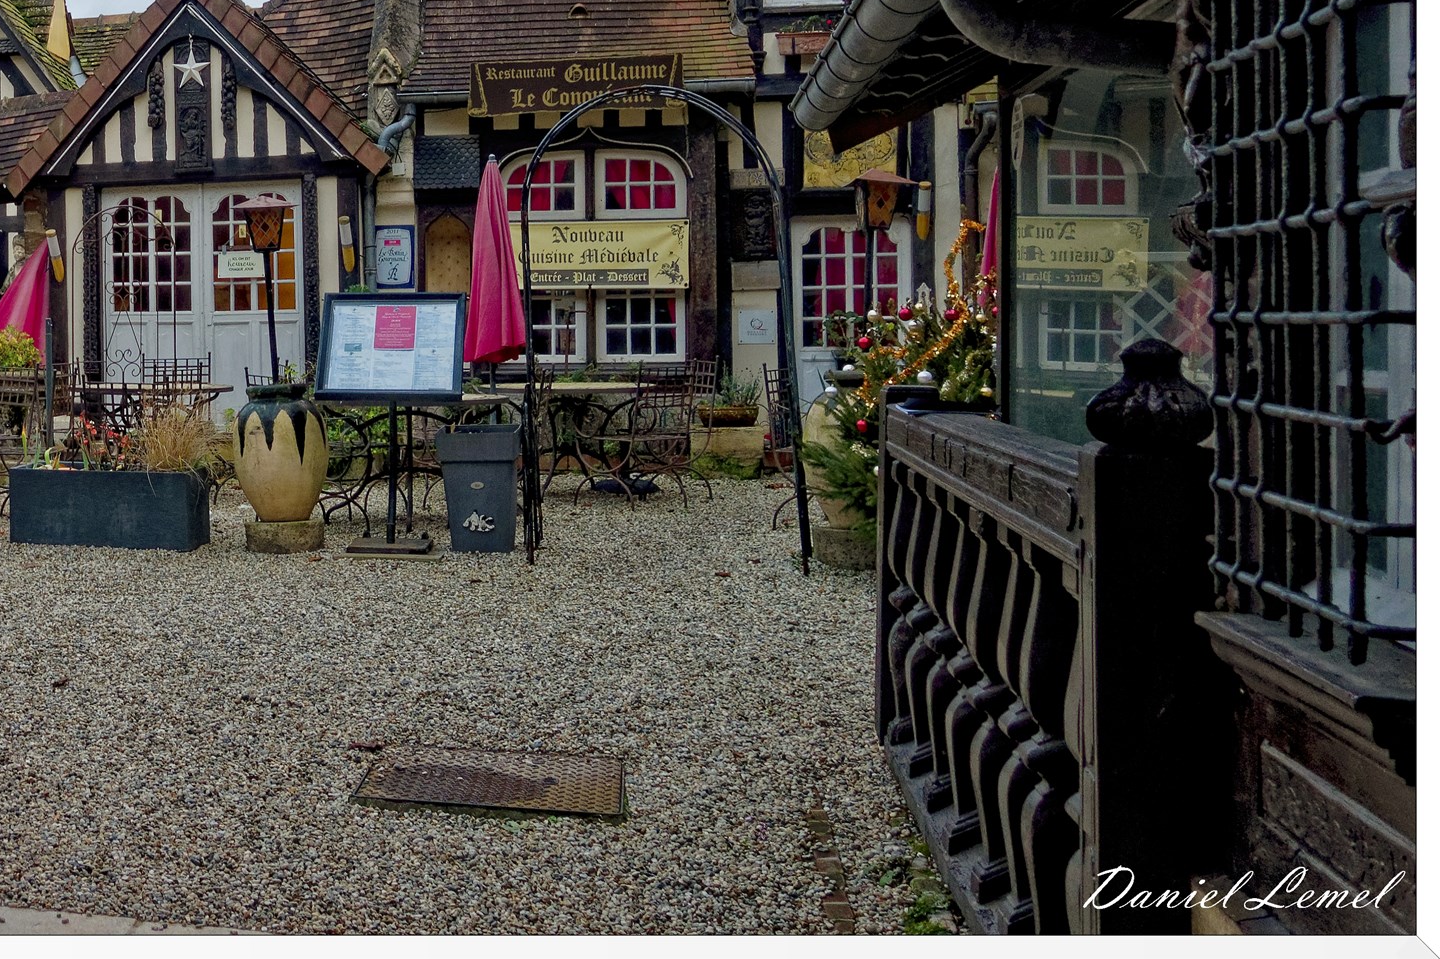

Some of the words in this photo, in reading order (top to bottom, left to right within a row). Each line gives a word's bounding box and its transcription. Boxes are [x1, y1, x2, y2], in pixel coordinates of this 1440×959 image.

[485, 66, 556, 81] Restaurant
[564, 62, 667, 83] Guillaume
[510, 88, 536, 109] Le
[552, 226, 624, 243] Nouveau
[579, 247, 659, 265] Médiévale
[530, 271, 562, 283] Entrée
[572, 271, 597, 284] Plat
[607, 271, 647, 283] Dessert
